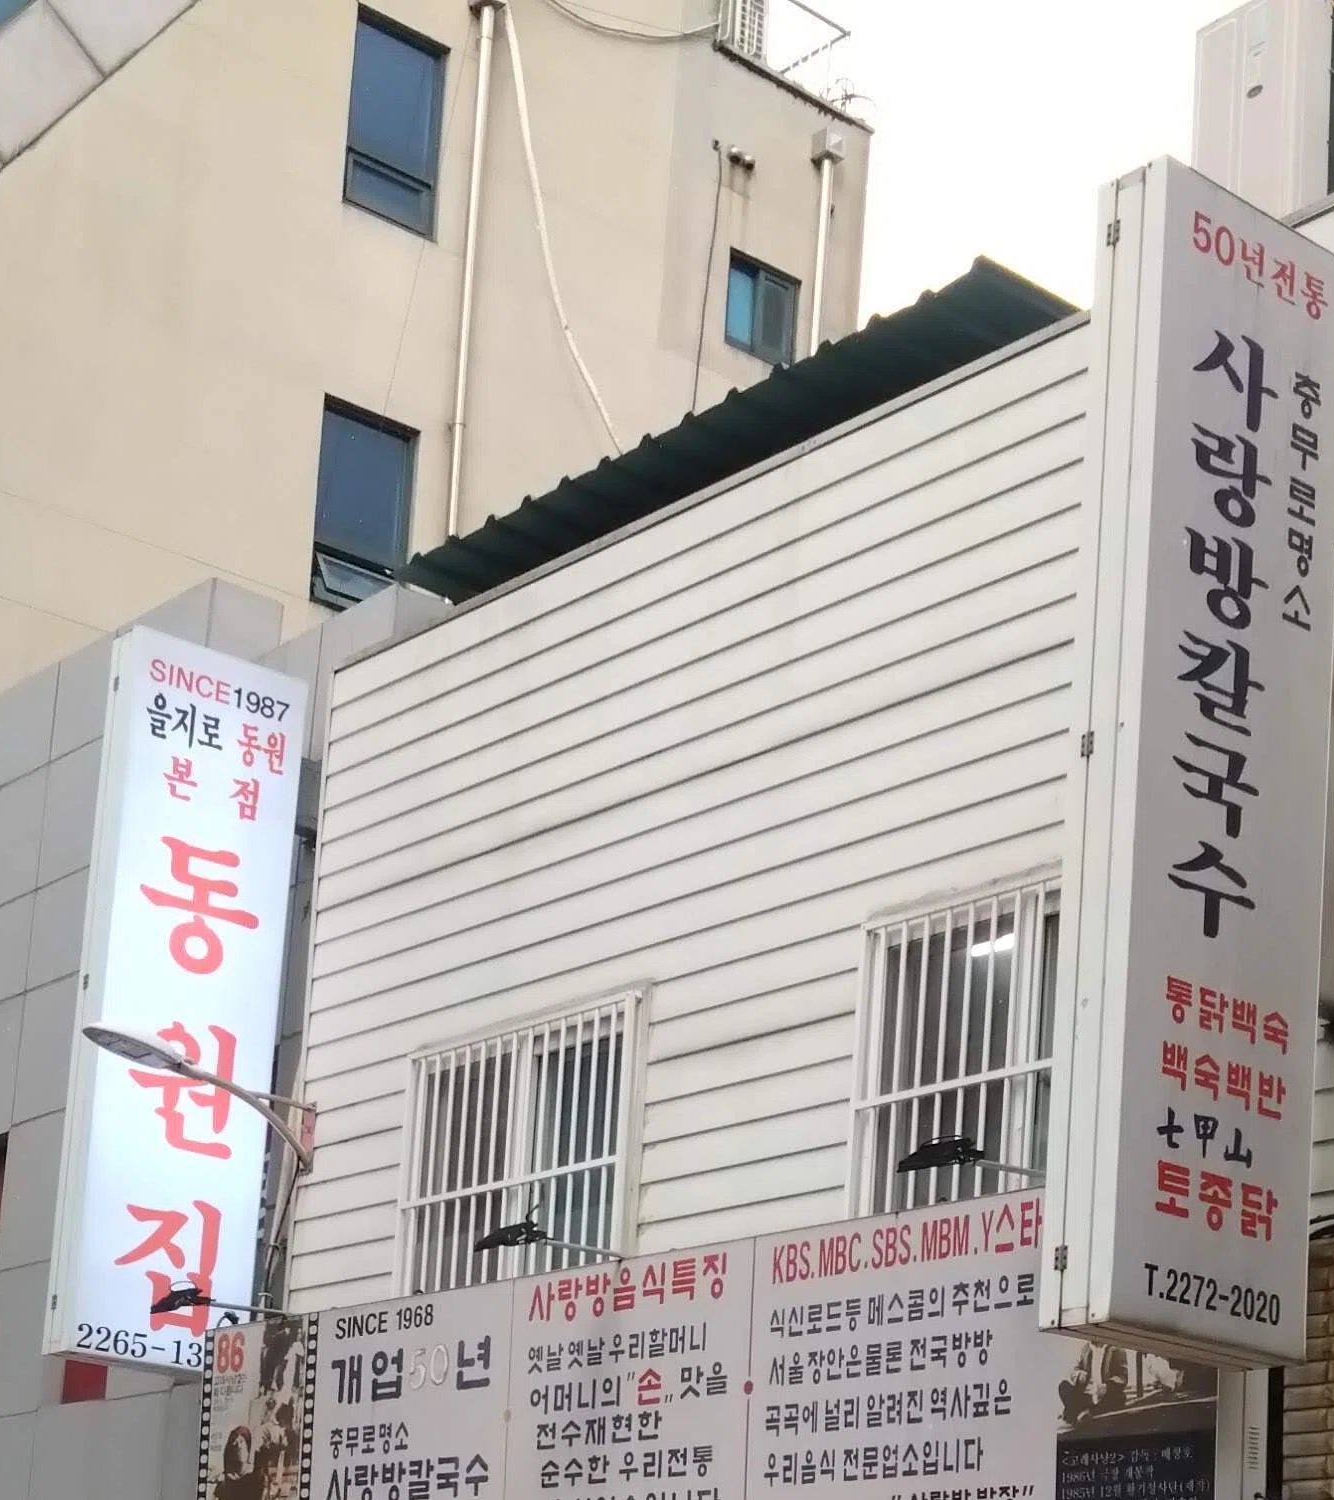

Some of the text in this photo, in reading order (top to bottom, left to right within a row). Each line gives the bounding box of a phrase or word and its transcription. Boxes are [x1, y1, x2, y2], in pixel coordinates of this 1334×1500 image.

[1282, 372, 1321, 631] 충무로명소
[1168, 329, 1278, 939] 사랑방칼국수
[146, 693, 285, 775] 을지로 동원
[1165, 975, 1290, 1056] 통닭백숙
[1162, 1040, 1286, 1122] 백숙백반
[1156, 1107, 1253, 1170] 七甲山
[1155, 1160, 1279, 1243] 토종닭
[335, 1304, 434, 1340] SINCE 1968
[1144, 1262, 1281, 1328] T.2272-2020
[76, 1323, 203, 1368] 2265-13
[217, 1331, 245, 1373] 86
[530, 1361, 727, 1415] 어머니의 맛을
[824, 1396, 860, 1432] 널리
[866, 1389, 923, 1428] 알려진
[329, 1421, 409, 1459] 충무로명소
[540, 1444, 715, 1489] 순수한 우리전통
[764, 1436, 984, 1487] 우리음식 전문업소입니다
